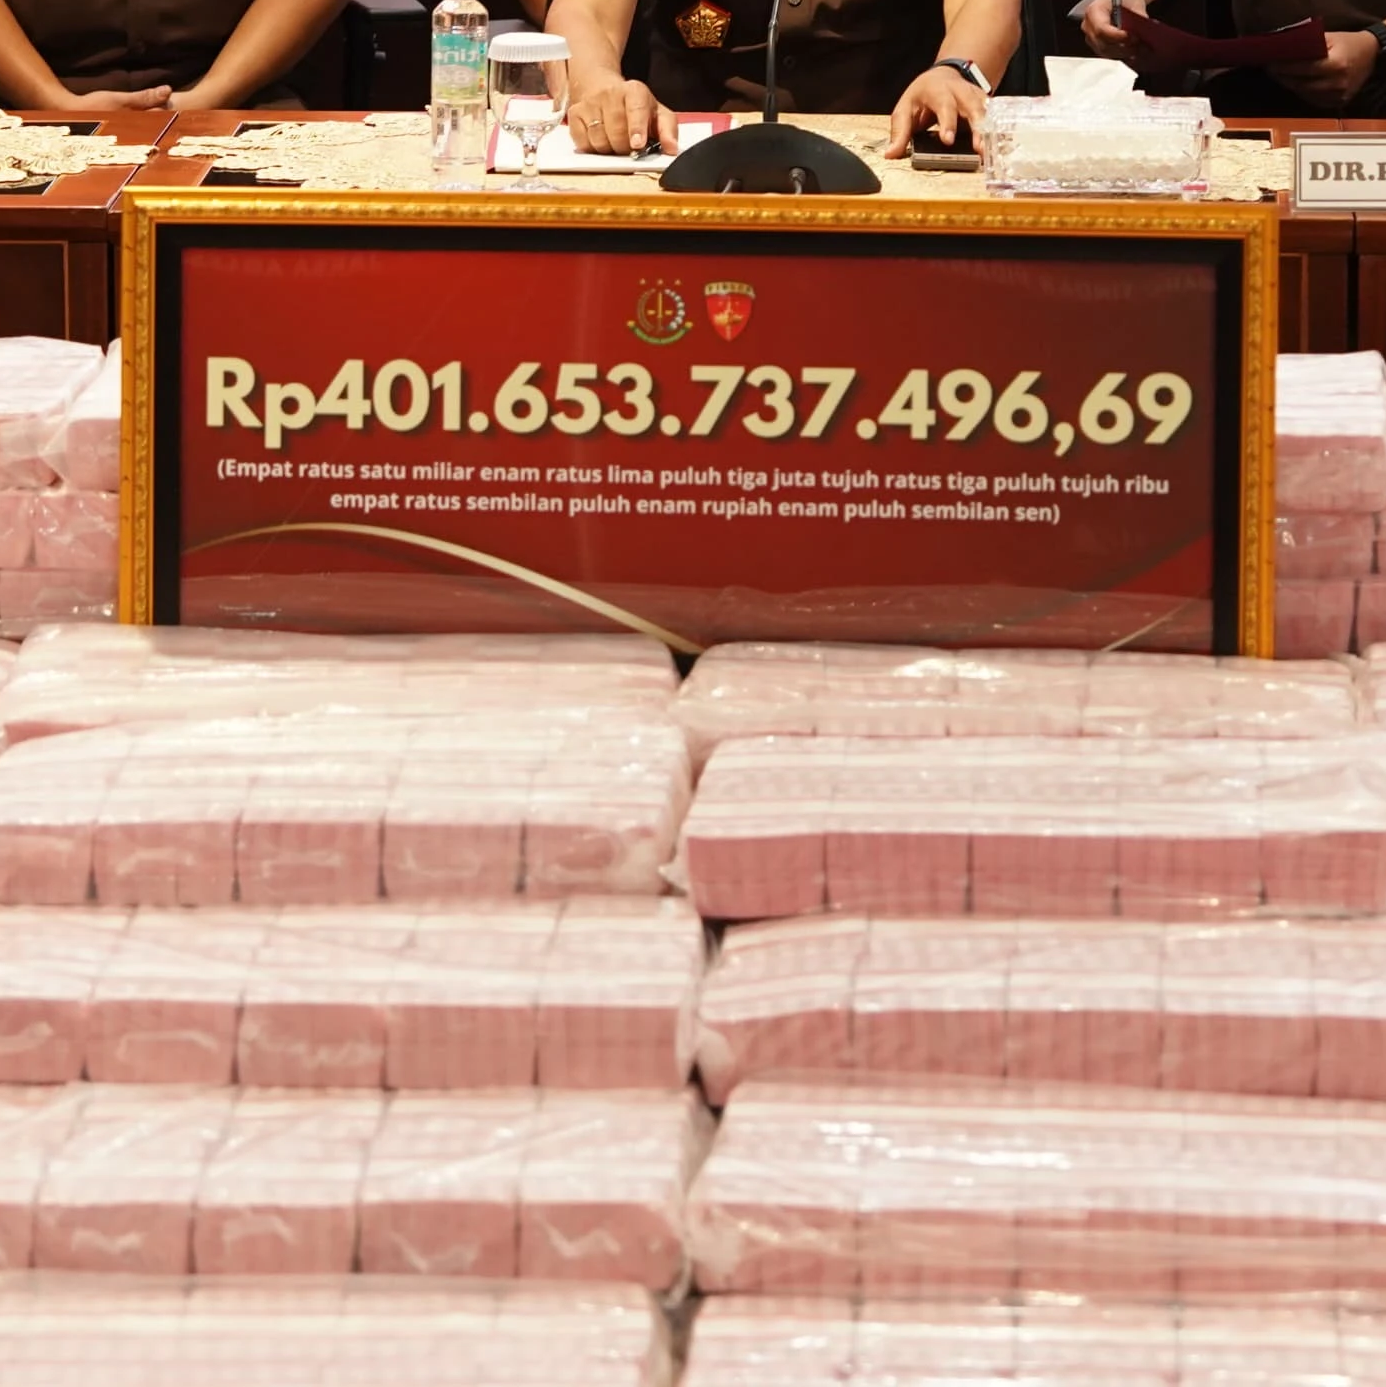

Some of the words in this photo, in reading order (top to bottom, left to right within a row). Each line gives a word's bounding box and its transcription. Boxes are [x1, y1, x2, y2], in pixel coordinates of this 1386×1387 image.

[206, 357, 1193, 457] Rp401.653.737.496,69
[217, 458, 293, 482] (Empat
[298, 461, 355, 479] ratus
[360, 463, 406, 480] satu
[412, 461, 475, 482] miliar
[479, 466, 540, 483] enam
[546, 464, 603, 484] ratus
[608, 465, 654, 485] lima
[660, 466, 722, 490] puluh
[727, 467, 768, 491] tiga
[771, 468, 816, 491] juta
[821, 469, 879, 493] tujuh
[885, 471, 942, 490] ratus
[947, 472, 988, 495] tiga
[993, 473, 1055, 495] puluh
[1061, 474, 1119, 497] tujuh
[1125, 475, 1169, 495] ribu
[330, 493, 399, 514] empat
[405, 493, 461, 511] ratus
[466, 493, 563, 513] sembilan
[569, 494, 631, 517] puluh
[636, 499, 696, 515] enam
[702, 497, 772, 520] rupiah
[778, 502, 838, 518] enam
[844, 499, 906, 522] puluh
[911, 501, 1009, 521] sembilan
[1015, 504, 1060, 525] sen)
